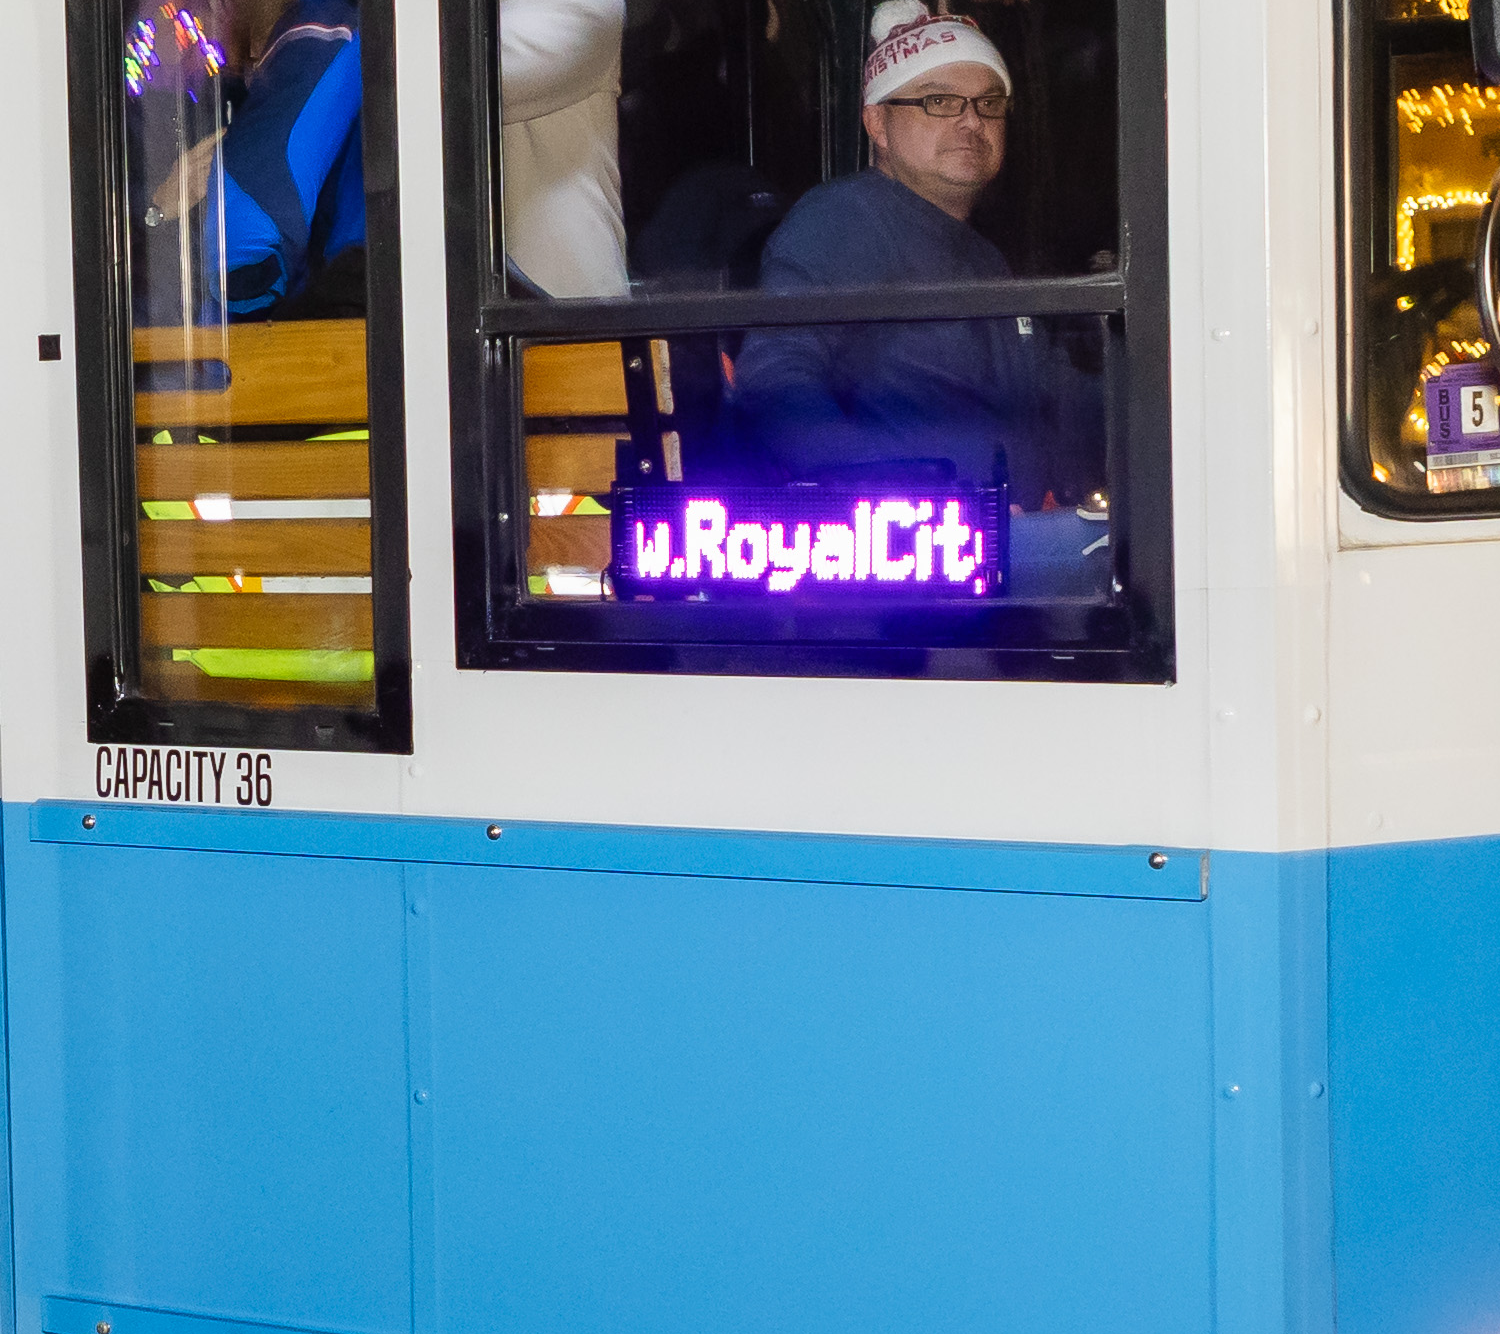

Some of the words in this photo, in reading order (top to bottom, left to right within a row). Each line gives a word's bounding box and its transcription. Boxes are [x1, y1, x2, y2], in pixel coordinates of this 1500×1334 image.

[1438, 388, 1451, 439] BUS
[1472, 391, 1484, 427] 5
[96, 746, 226, 803] CAPACITY
[236, 752, 272, 806] 36
